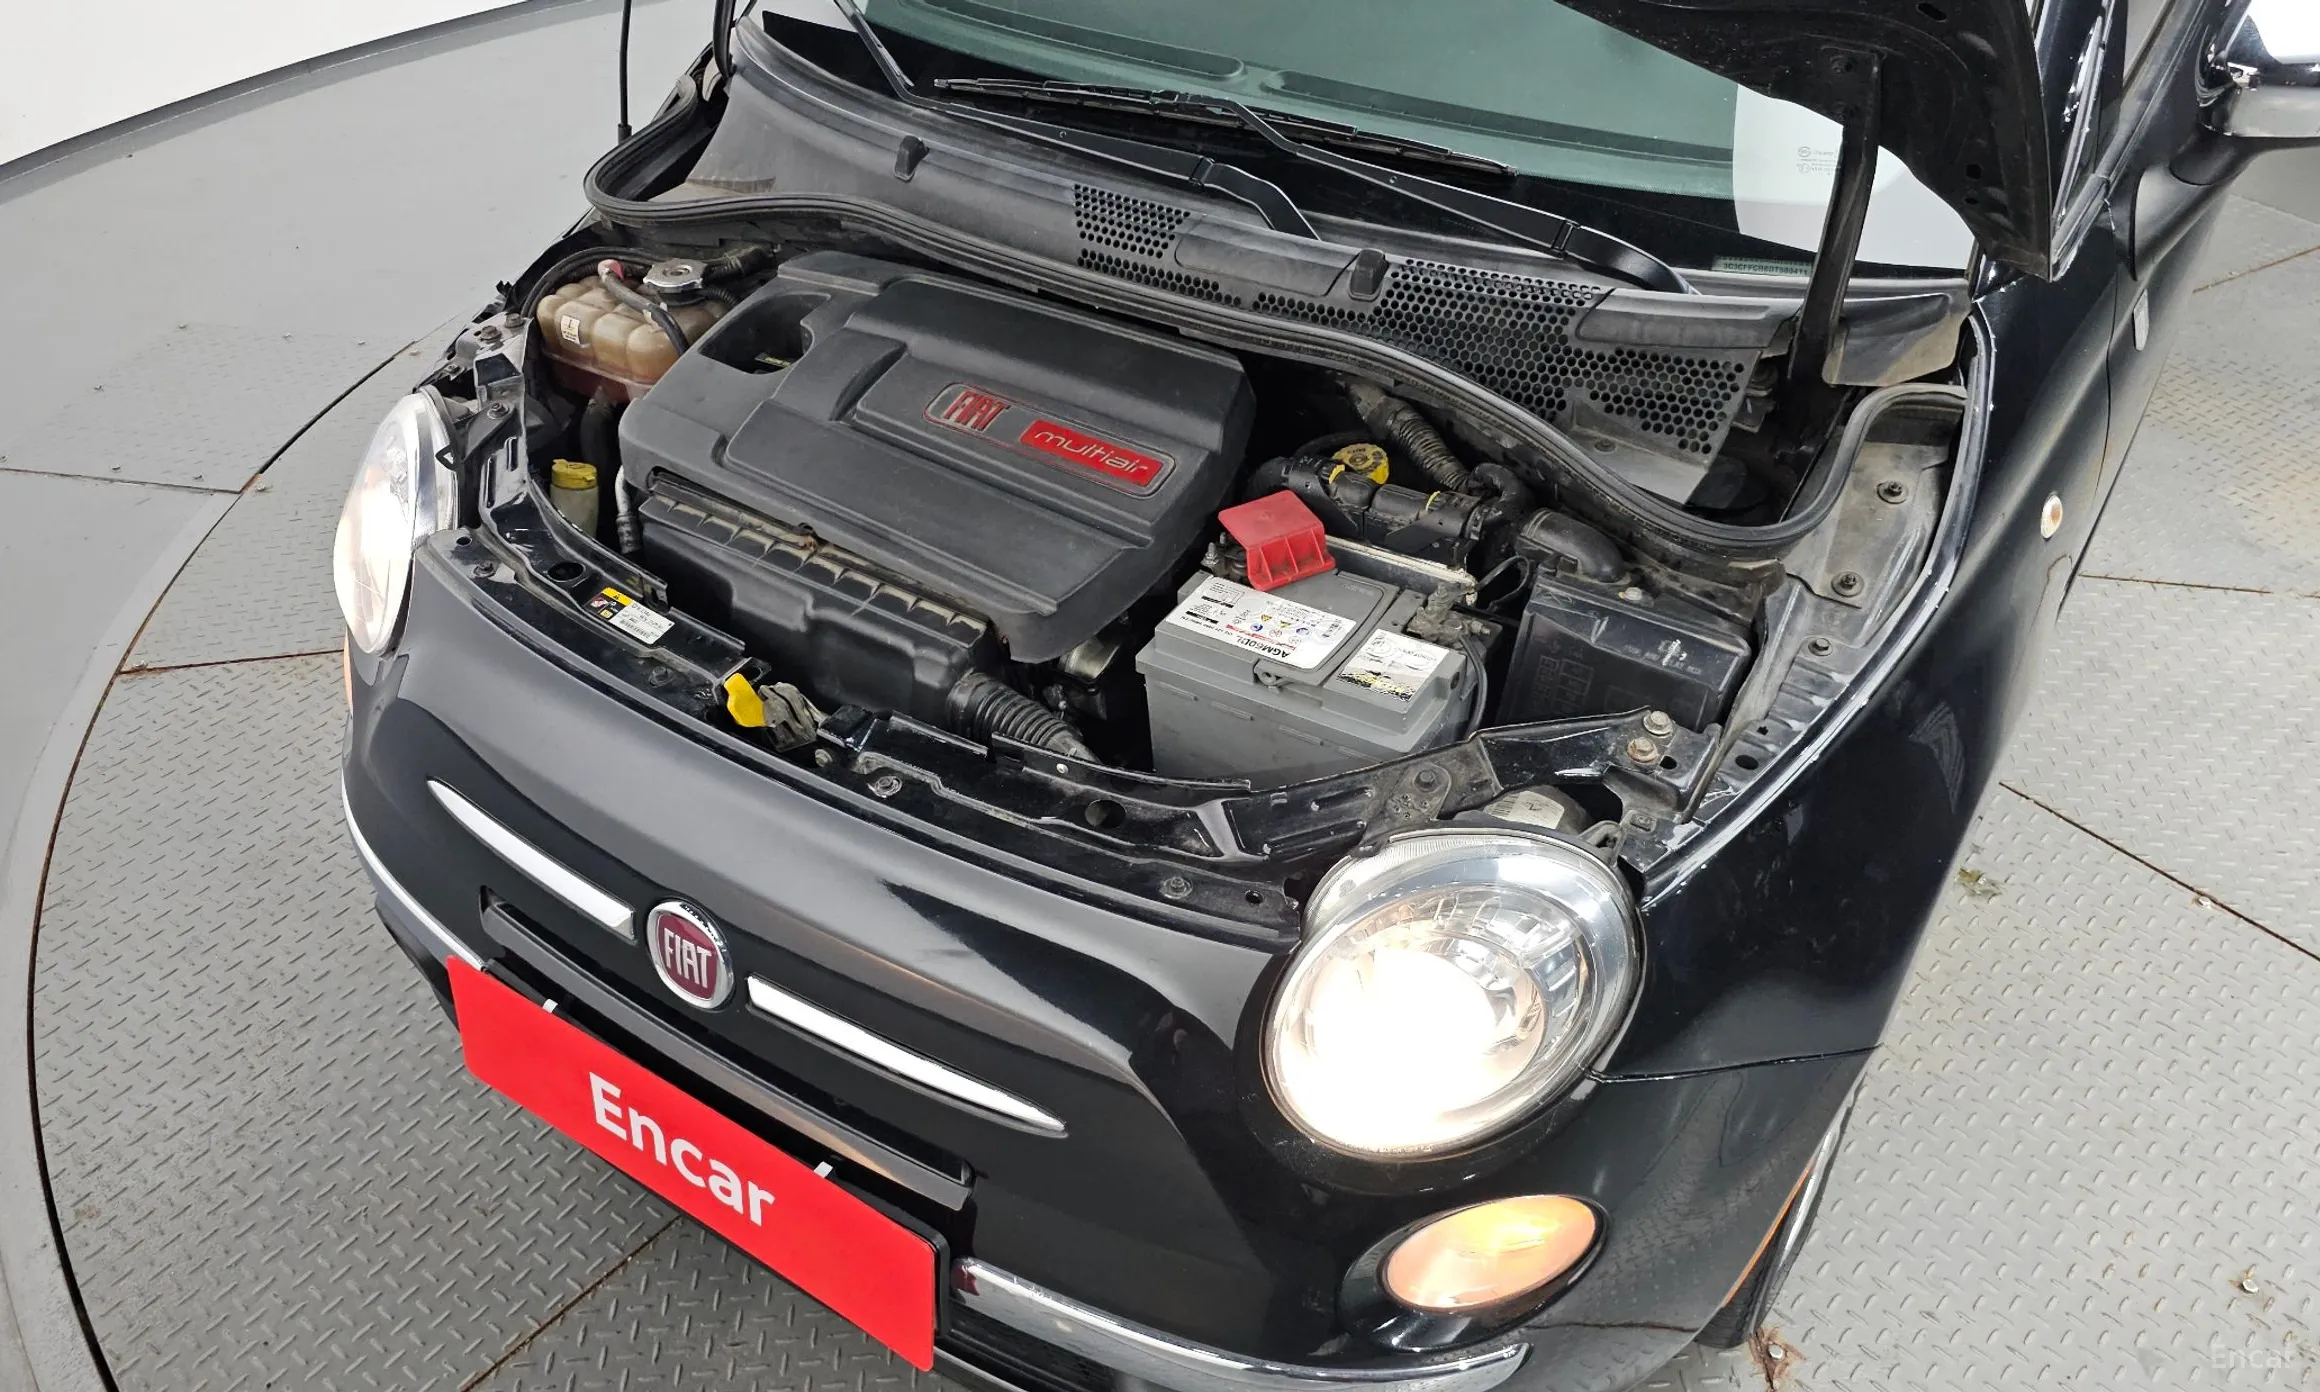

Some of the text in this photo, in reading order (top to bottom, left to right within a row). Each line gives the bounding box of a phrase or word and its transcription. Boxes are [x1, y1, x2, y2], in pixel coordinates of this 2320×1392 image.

[943, 390, 1011, 432] FIAT
[1034, 430, 1149, 474] multiair
[663, 927, 713, 989] FIAT
[588, 1071, 776, 1227] Encar
